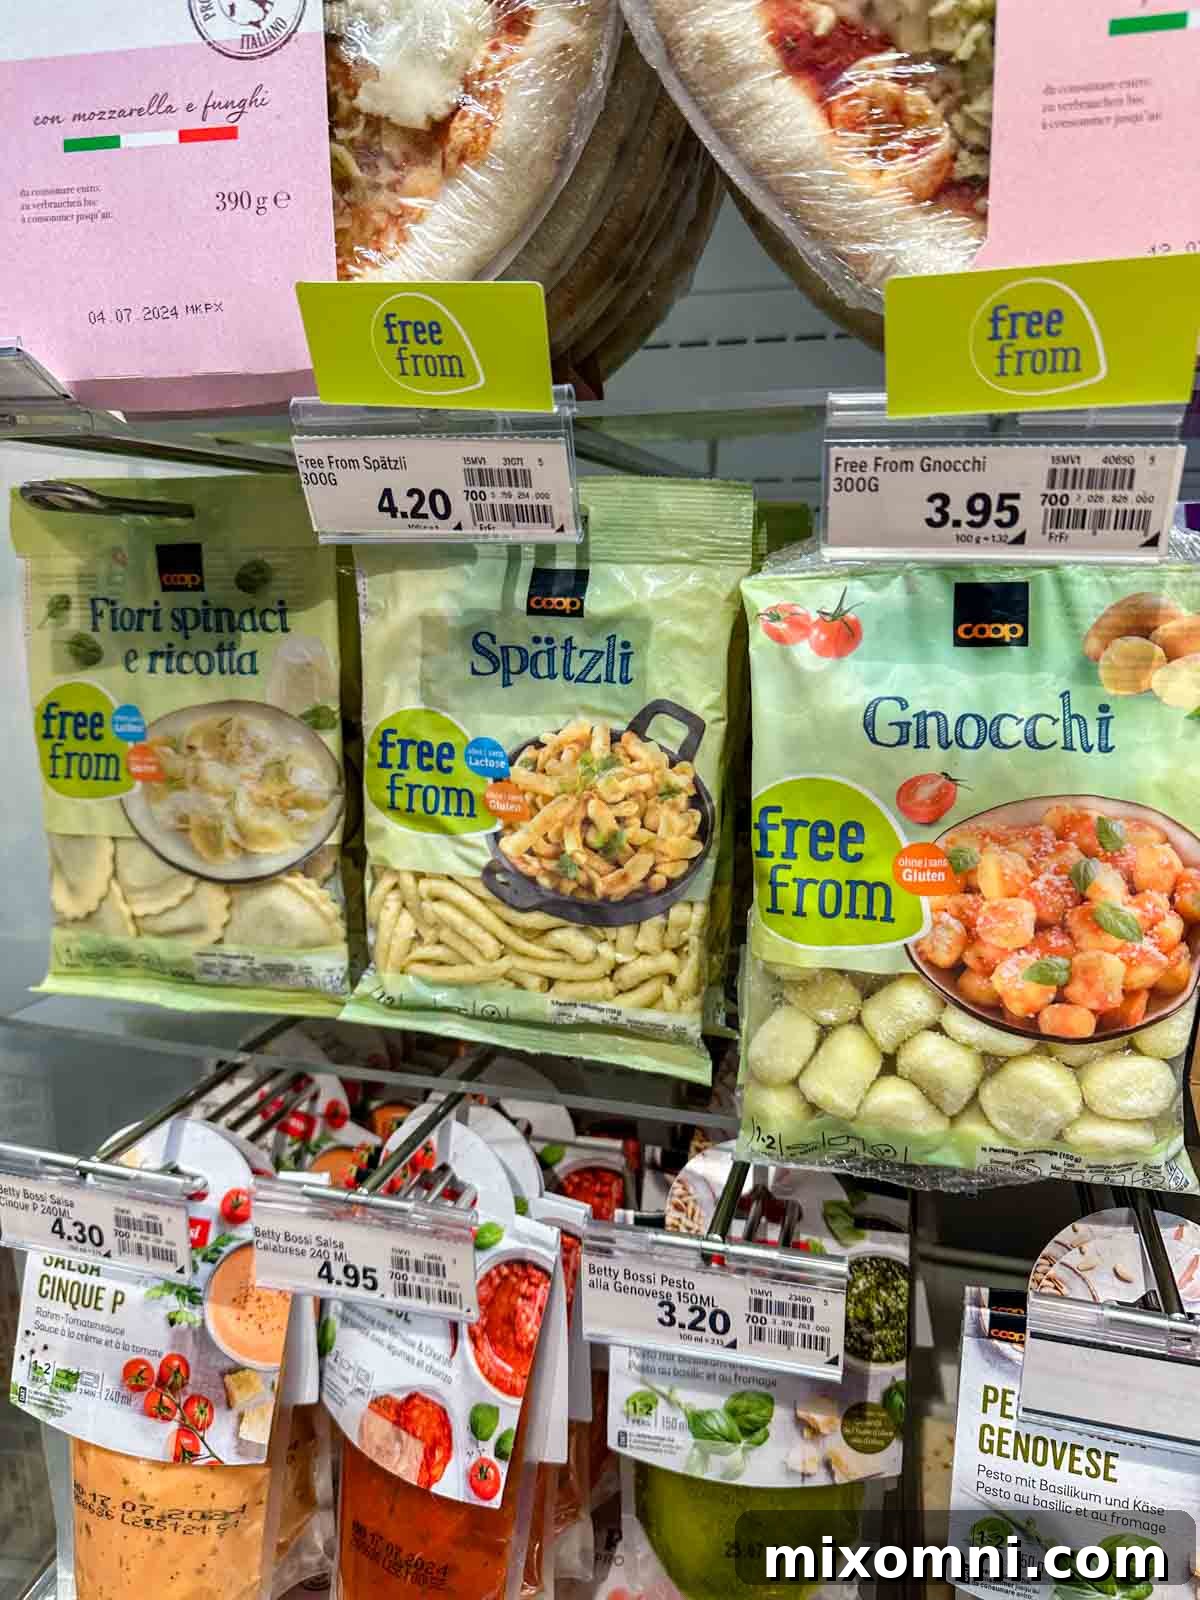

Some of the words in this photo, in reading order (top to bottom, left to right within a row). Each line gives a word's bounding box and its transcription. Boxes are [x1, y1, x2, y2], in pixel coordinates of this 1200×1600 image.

[240, 17, 288, 49] ITALIANO
[33, 113, 65, 126] con
[72, 92, 177, 122] mozzarella
[186, 103, 197, 113] e
[201, 83, 270, 123] funghi
[215, 191, 251, 211] 390
[256, 197, 267, 215] g
[384, 313, 443, 345] free
[987, 305, 1064, 341] free
[396, 347, 465, 378] from
[994, 343, 1082, 377] from
[327, 456, 360, 469] From
[363, 456, 407, 472] Spätzli
[834, 456, 868, 473] Free
[873, 456, 914, 472] From
[920, 456, 986, 473] Gnocchi
[463, 490, 487, 501] 700
[833, 478, 879, 492] 300G
[1040, 493, 1070, 506] 700
[378, 488, 452, 520] 4.20
[924, 492, 1021, 528] 3.95
[161, 573, 201, 588] coop
[89, 597, 163, 634] Fiori
[171, 600, 291, 640] spinaci
[530, 596, 582, 611] coop
[957, 621, 1024, 640] coop
[124, 649, 139, 674] e
[147, 643, 259, 676] ricotta
[470, 631, 635, 688] Spätzli
[41, 703, 105, 741] free
[862, 690, 1116, 753] Gnocchi
[49, 744, 121, 781] from
[377, 729, 455, 774] free
[386, 774, 477, 818] from
[753, 806, 866, 863] free
[902, 868, 945, 882] Gluten
[764, 864, 896, 924] from
[51, 1217, 104, 1247] 4.30
[255, 1226, 281, 1241] Betty
[284, 1231, 312, 1245] Bossi
[315, 1235, 344, 1249] Salsa
[255, 1240, 307, 1257] Calabrese
[309, 1247, 330, 1260] 240
[317, 1260, 379, 1291] 4.95
[390, 1271, 408, 1281] 700
[588, 1263, 620, 1280] Betty
[623, 1268, 656, 1284] Bossi
[660, 1274, 695, 1291] Pesto
[38, 1273, 106, 1311] CINQUE
[112, 1289, 125, 1315] P
[588, 1278, 609, 1291] alla
[614, 1281, 673, 1302] Genovese
[677, 1290, 719, 1308] 150ML
[33, 1320, 59, 1335] Sauce
[657, 1300, 731, 1335] 3.20
[745, 1313, 768, 1325] 700
[991, 1328, 1025, 1342] coop
[104, 1389, 121, 1404] 240
[982, 1384, 1016, 1420] PE
[978, 1423, 1119, 1484] GENOVESE
[977, 1464, 1012, 1483] Pesto
[1015, 1475, 1037, 1489] mit
[1039, 1479, 1102, 1504] Basilikum
[1105, 1496, 1129, 1510] und
[1133, 1499, 1165, 1517] Käse
[976, 1481, 1011, 1500] Pesto
[1014, 1493, 1030, 1504] au
[1033, 1495, 1072, 1514] basilic
[1075, 1505, 1089, 1517] et
[1091, 1511, 1108, 1523] au
[1111, 1512, 1167, 1536] fromage
